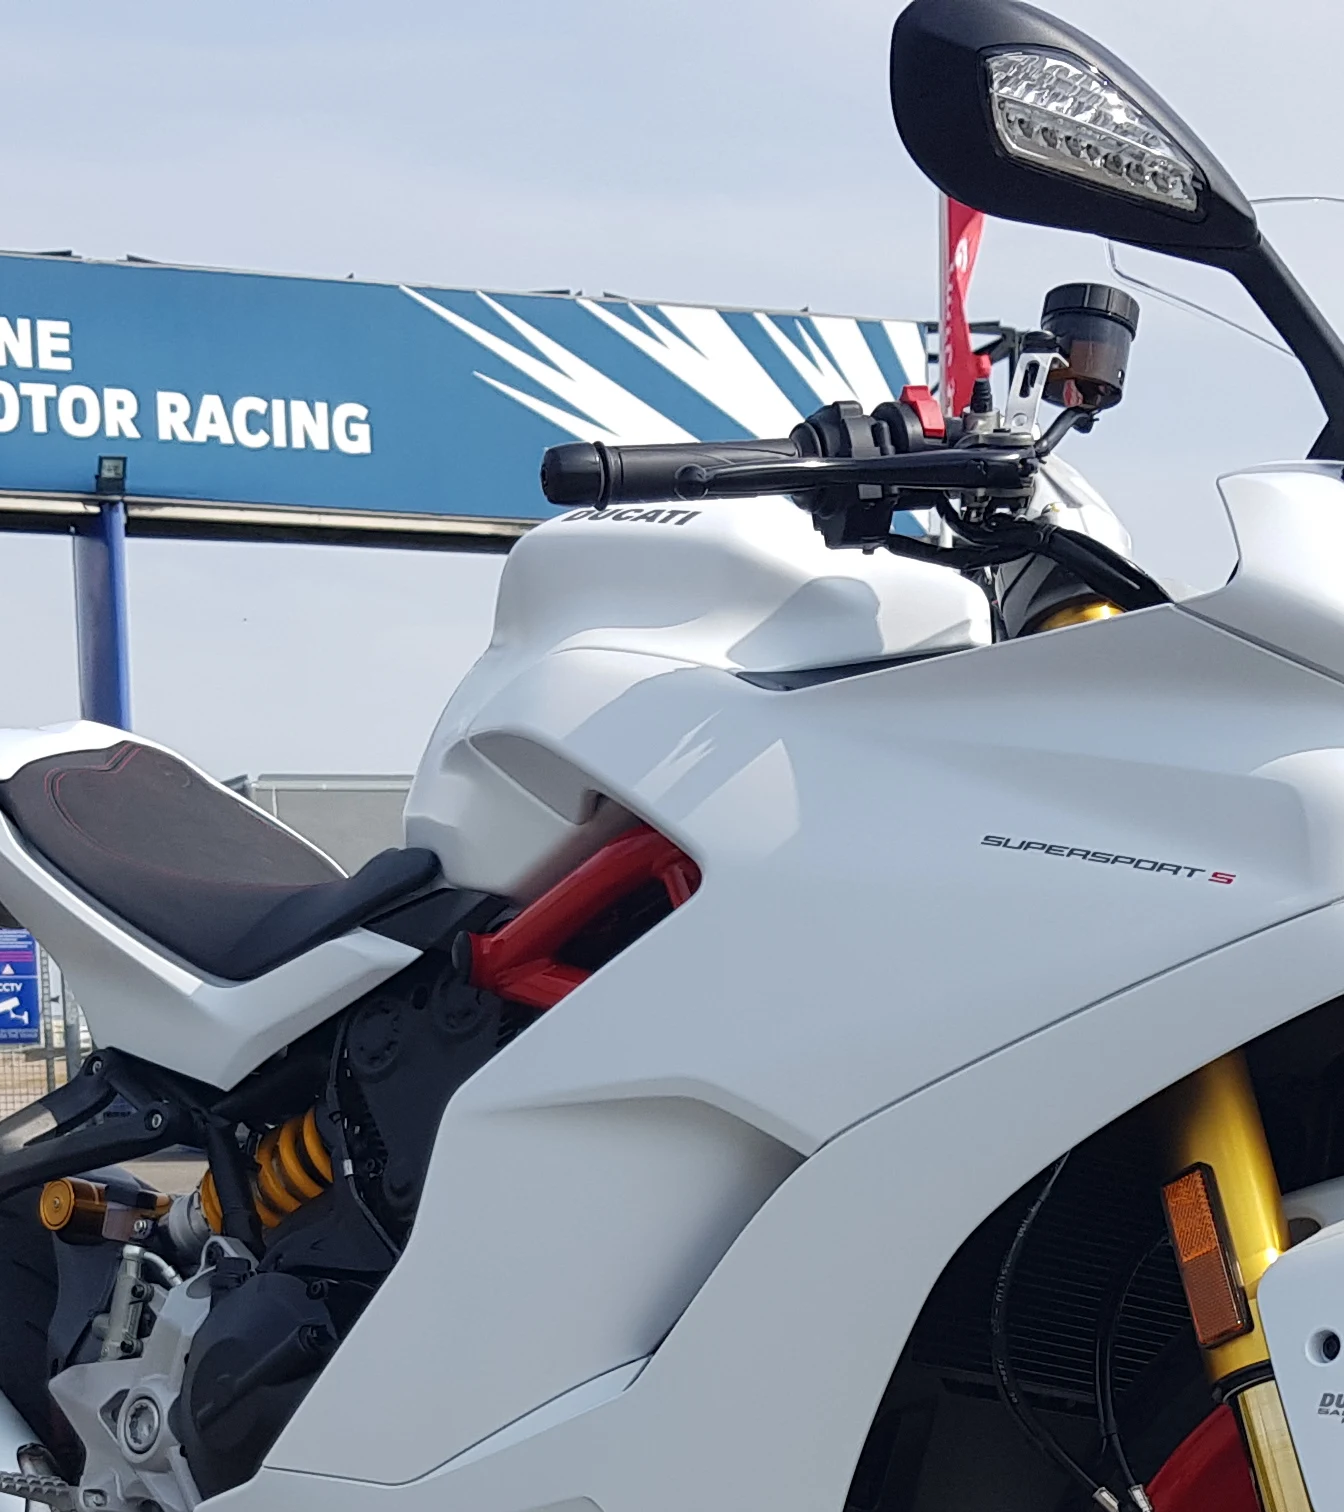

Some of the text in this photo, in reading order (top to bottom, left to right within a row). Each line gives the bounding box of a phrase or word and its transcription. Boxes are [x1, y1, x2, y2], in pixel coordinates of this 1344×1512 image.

[156, 390, 373, 455] RACING
[561, 508, 702, 526] DUCATI
[980, 834, 1237, 885] SUPERSPORT S
